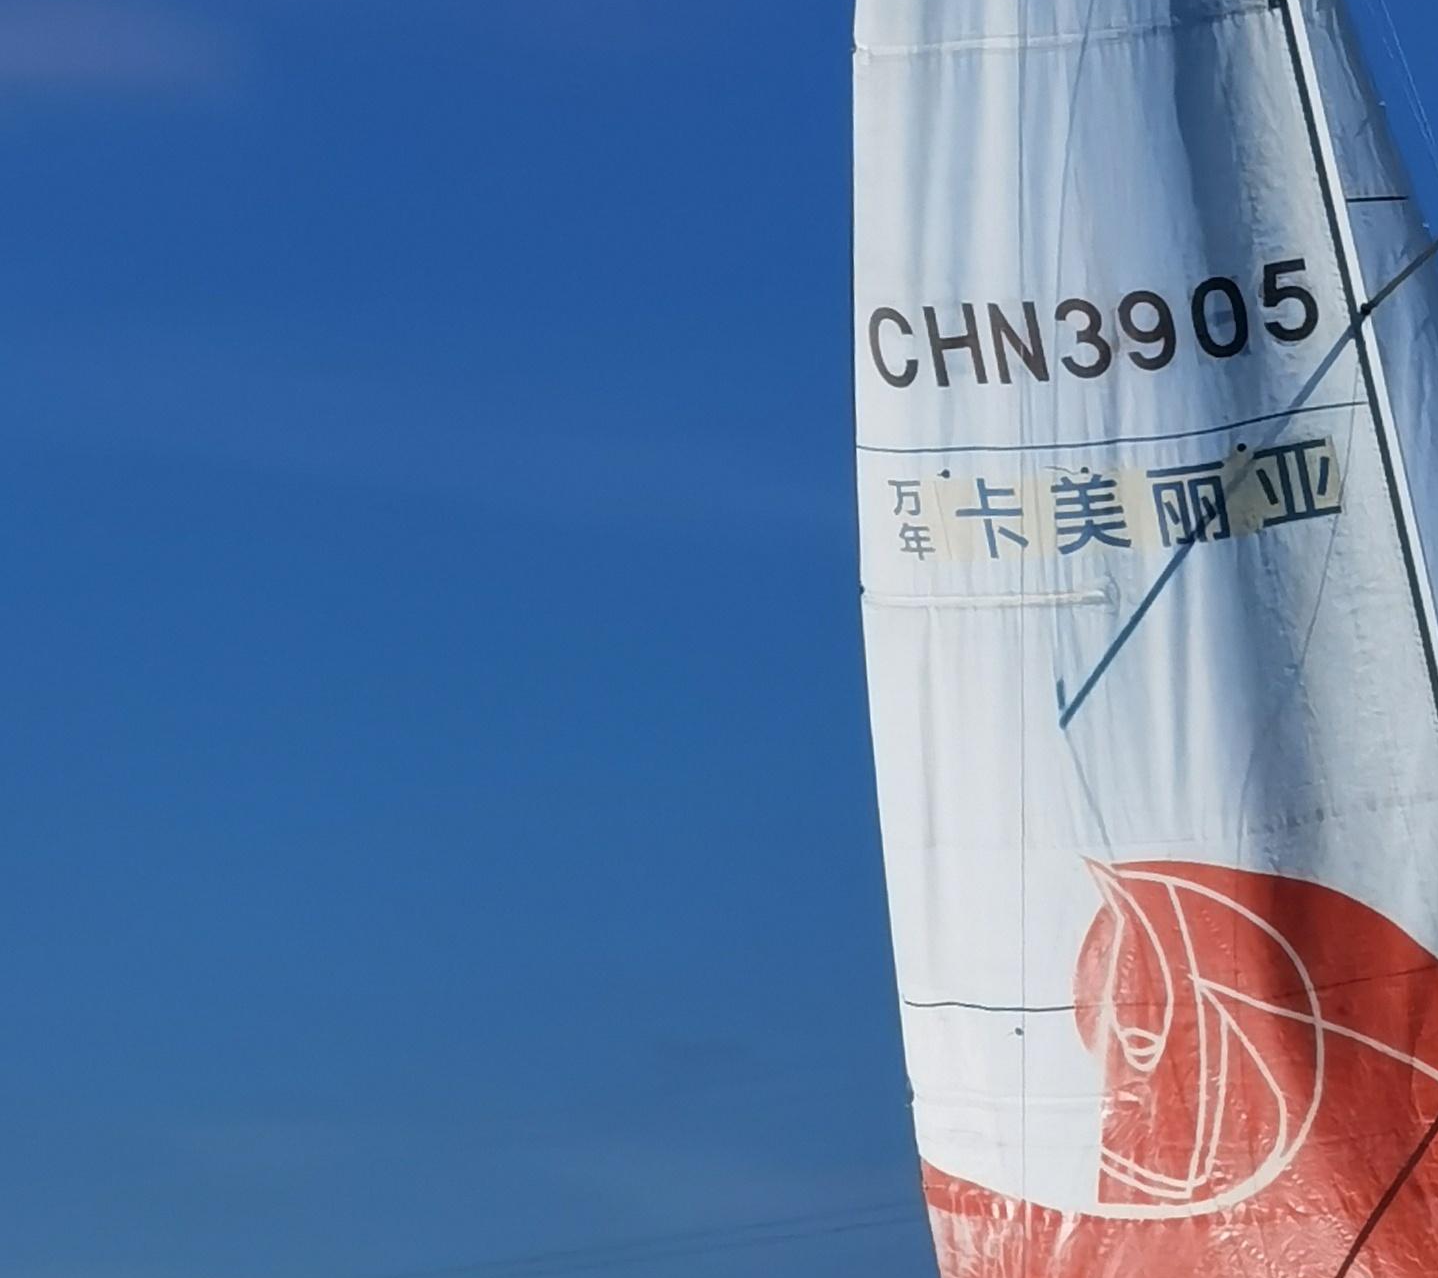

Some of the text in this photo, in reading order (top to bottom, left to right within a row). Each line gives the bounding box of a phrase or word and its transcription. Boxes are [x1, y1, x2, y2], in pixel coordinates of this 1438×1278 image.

[868, 258, 1320, 389] CHN3905
[955, 438, 1342, 559] 卡美丽亚
